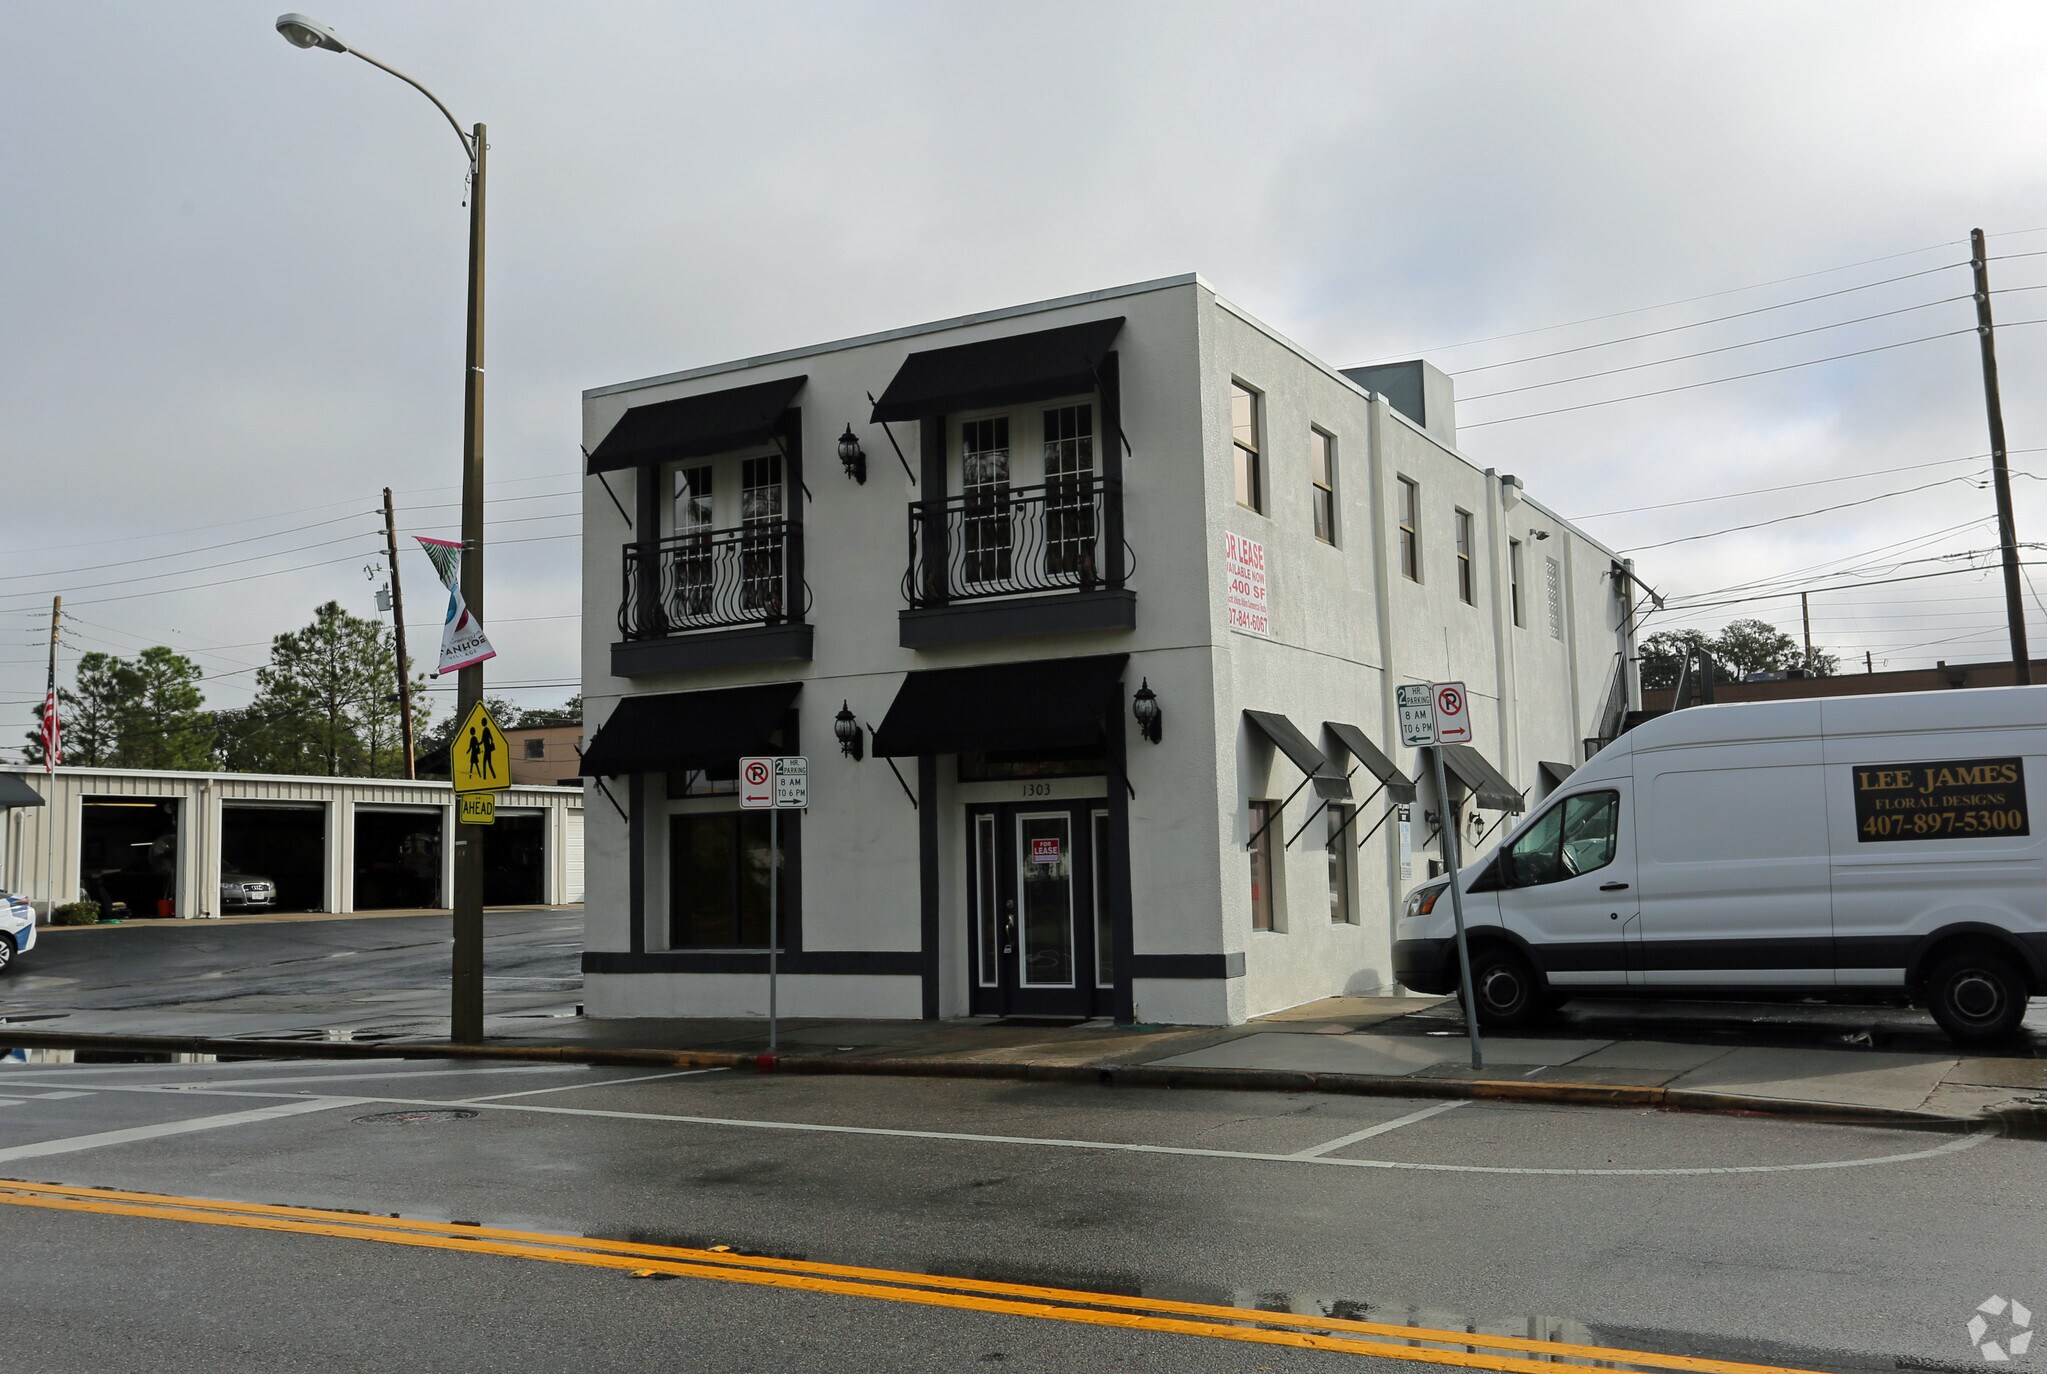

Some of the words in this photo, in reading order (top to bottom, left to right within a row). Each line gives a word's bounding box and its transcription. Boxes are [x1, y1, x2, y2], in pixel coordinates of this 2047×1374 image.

[1238, 537, 1264, 571] LEASE
[1251, 570, 1265, 585] NOW
[1253, 585, 1266, 600] SF
[440, 635, 486, 657] ANHOE
[1398, 689, 1406, 705] 2
[1407, 696, 1430, 705] PARKING
[1405, 711, 1411, 720] 8
[1414, 710, 1427, 719] AM
[1404, 724, 1413, 733] TO
[1415, 724, 1420, 732] 6
[1422, 723, 1433, 732] PM
[775, 760, 783, 773] 2
[1859, 770, 1914, 791] LEE
[1919, 764, 2019, 794] JAMES
[1023, 783, 1051, 797] 1303
[462, 800, 493, 815] AHEAD
[1875, 797, 1939, 811] FLORAL
[1942, 793, 2006, 807] DESIGNS
[1863, 809, 2023, 836] 407-897-5300
[1034, 847, 1058, 855] LEASE
